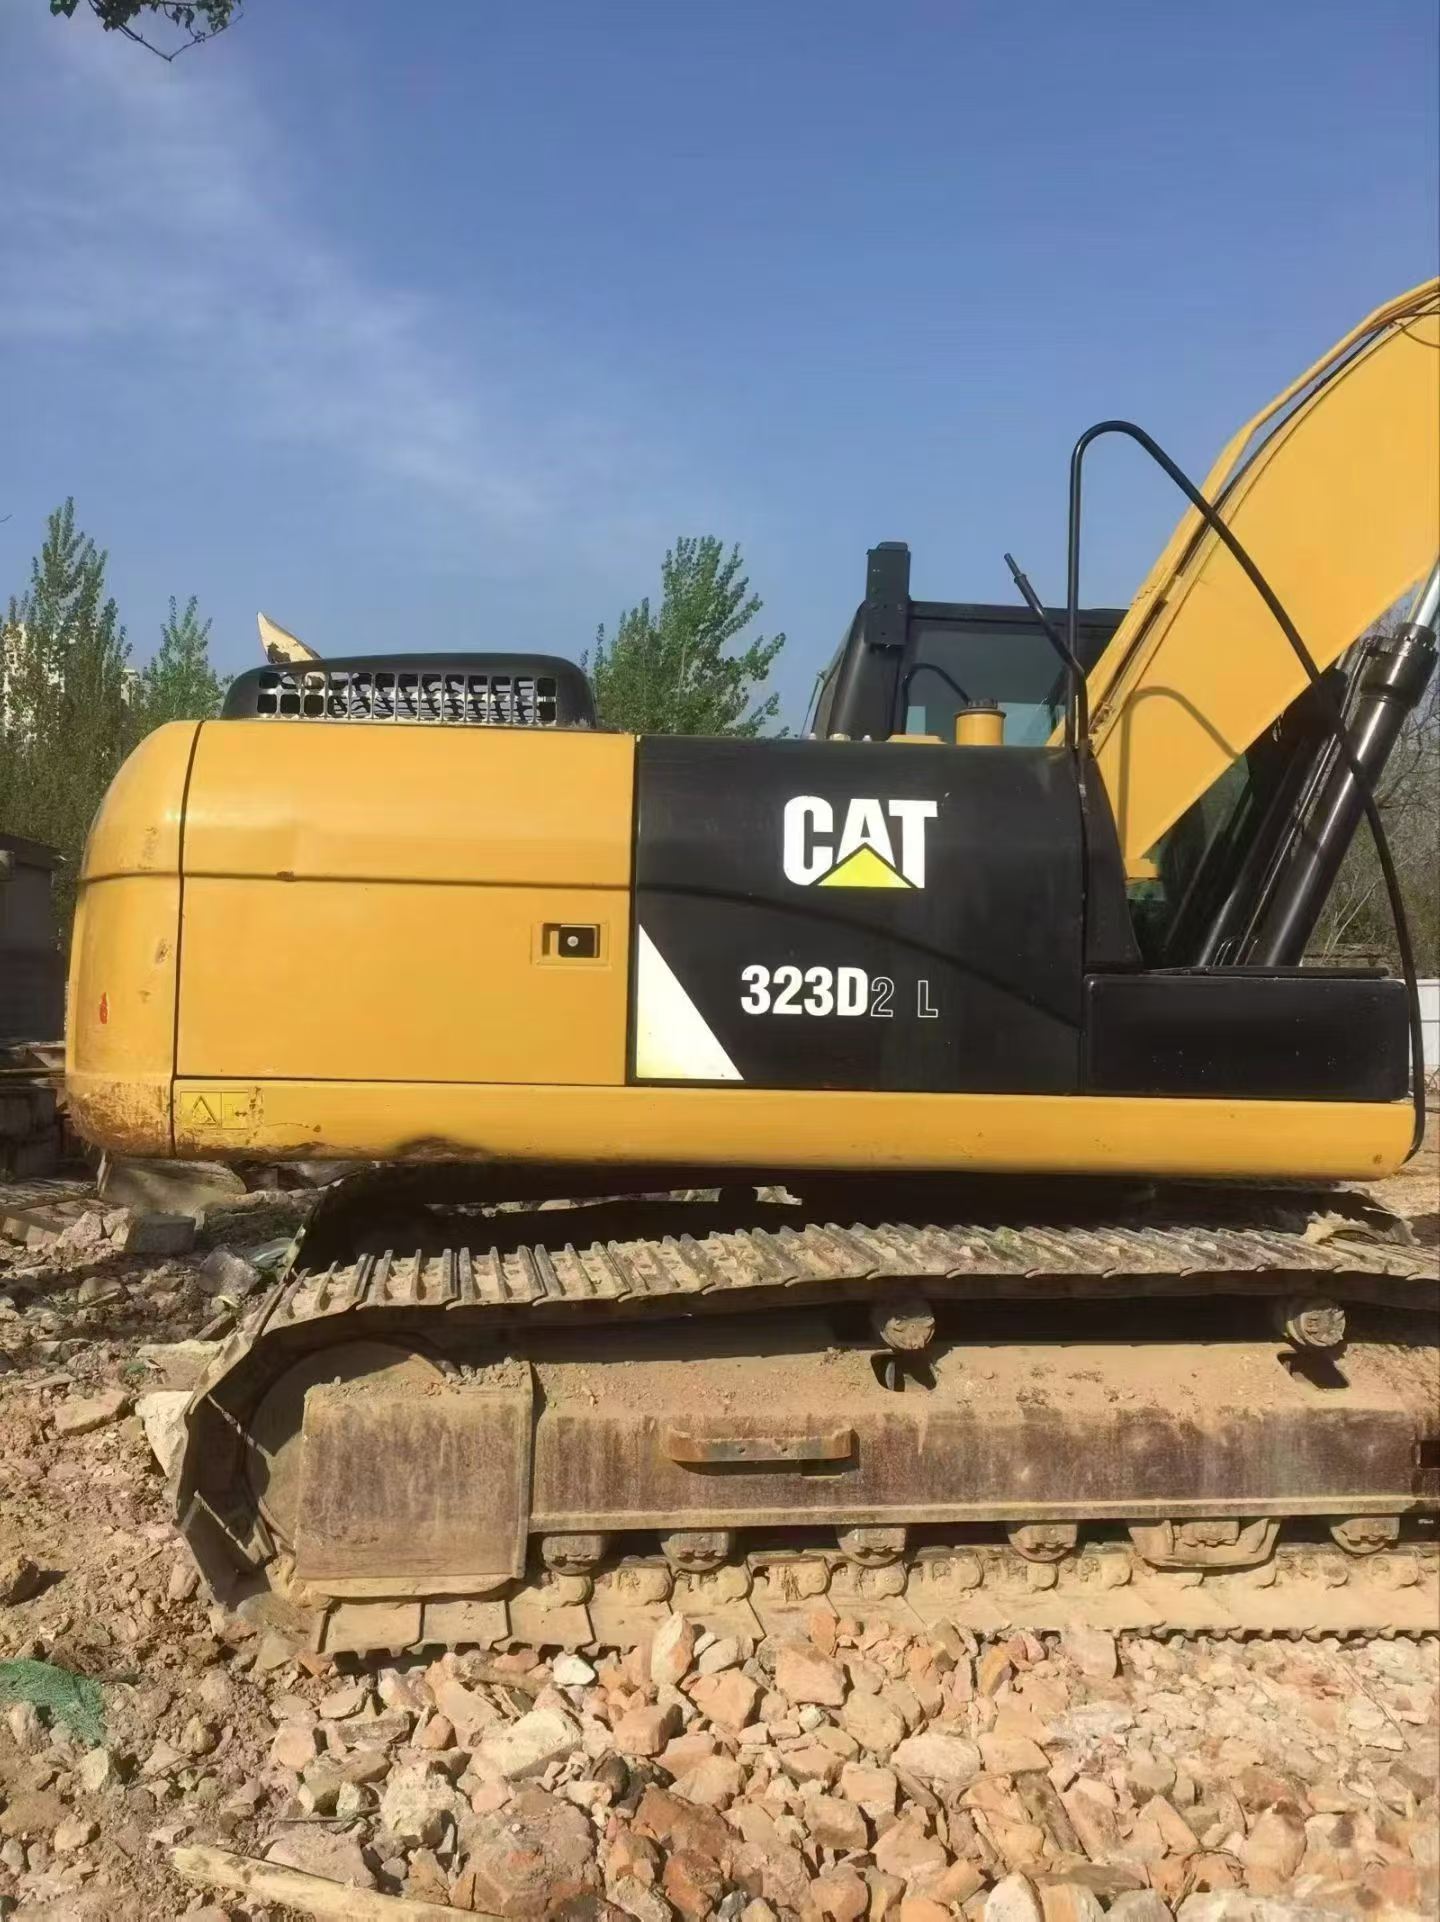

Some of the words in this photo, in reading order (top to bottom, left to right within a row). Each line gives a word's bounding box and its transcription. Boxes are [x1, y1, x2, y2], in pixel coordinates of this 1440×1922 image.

[783, 795, 938, 889] CAT
[740, 964, 895, 1018] 323D2
[917, 980, 939, 1018] L
